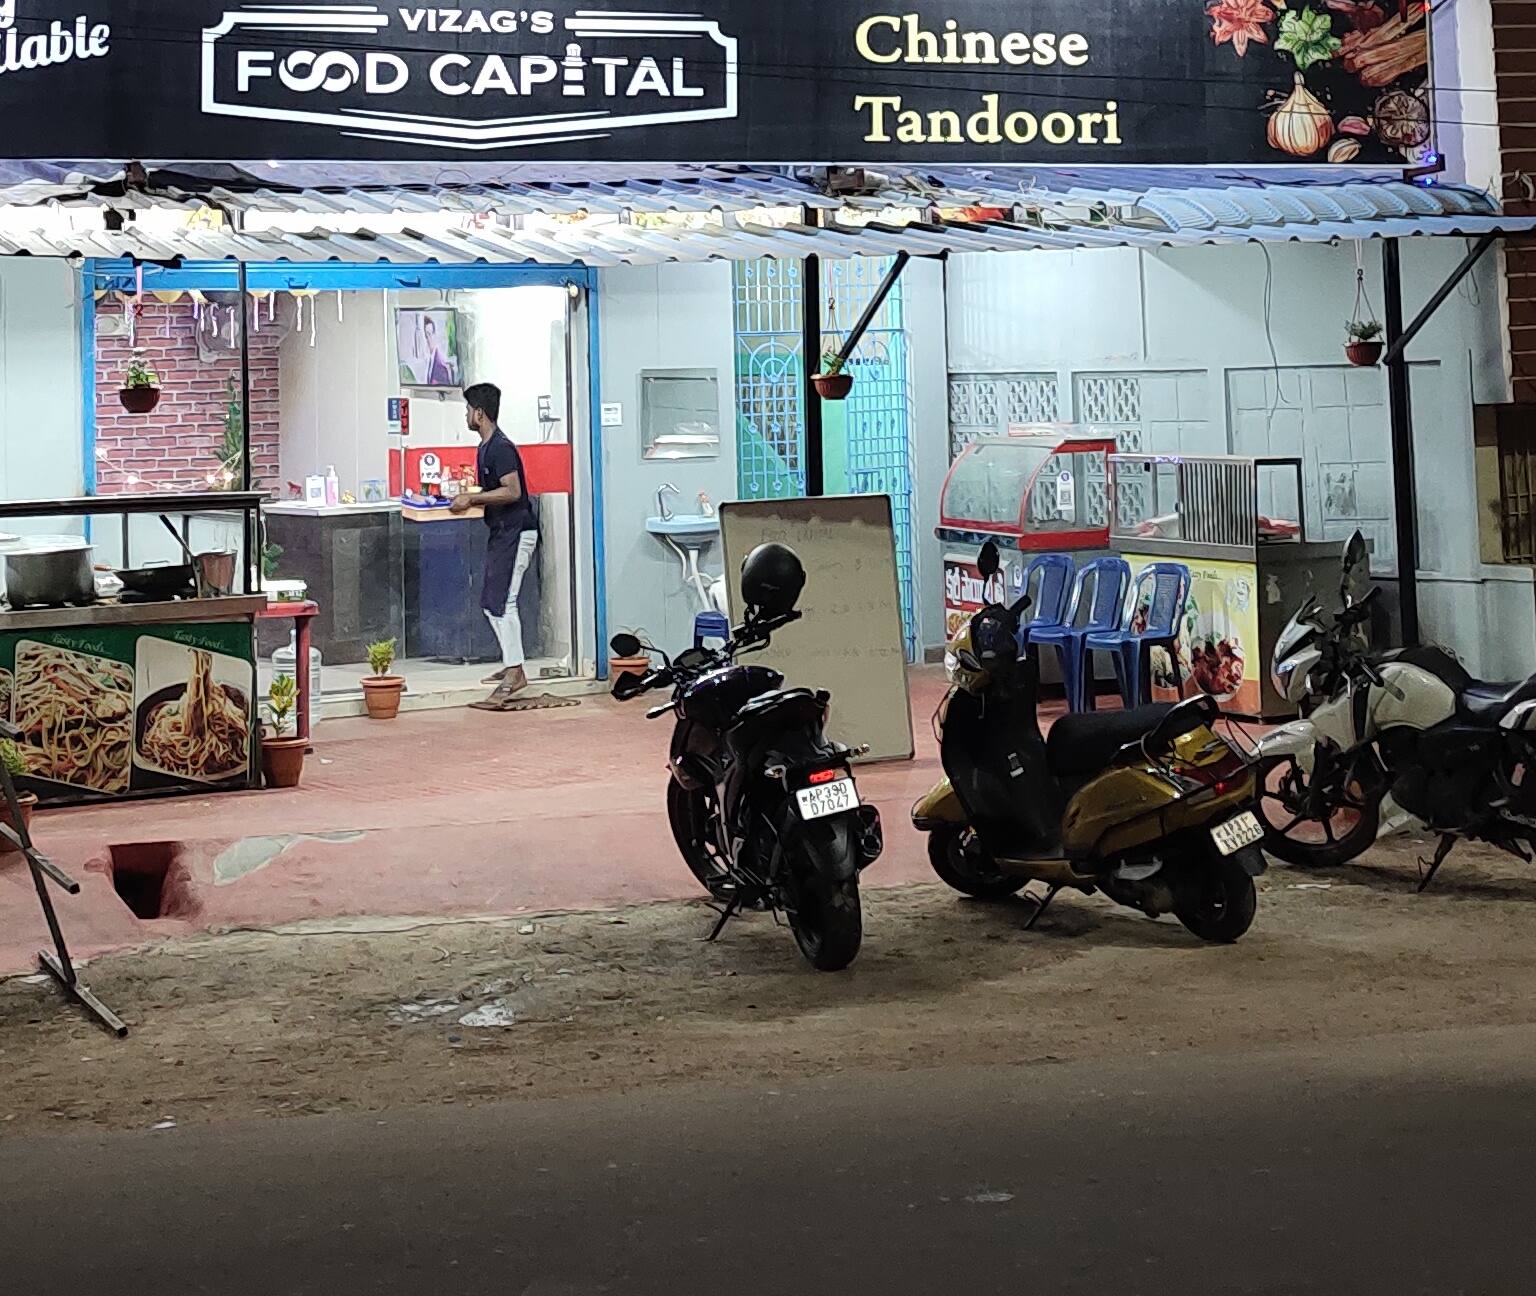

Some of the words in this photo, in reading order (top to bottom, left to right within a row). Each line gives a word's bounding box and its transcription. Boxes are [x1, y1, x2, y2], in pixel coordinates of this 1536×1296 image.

[398, 7, 554, 34] VIZAG'S
[854, 13, 1090, 67] Chinese
[236, 50, 409, 96] FOOD
[429, 43, 705, 97] CAPITAL
[854, 93, 1123, 145] Tandoori
